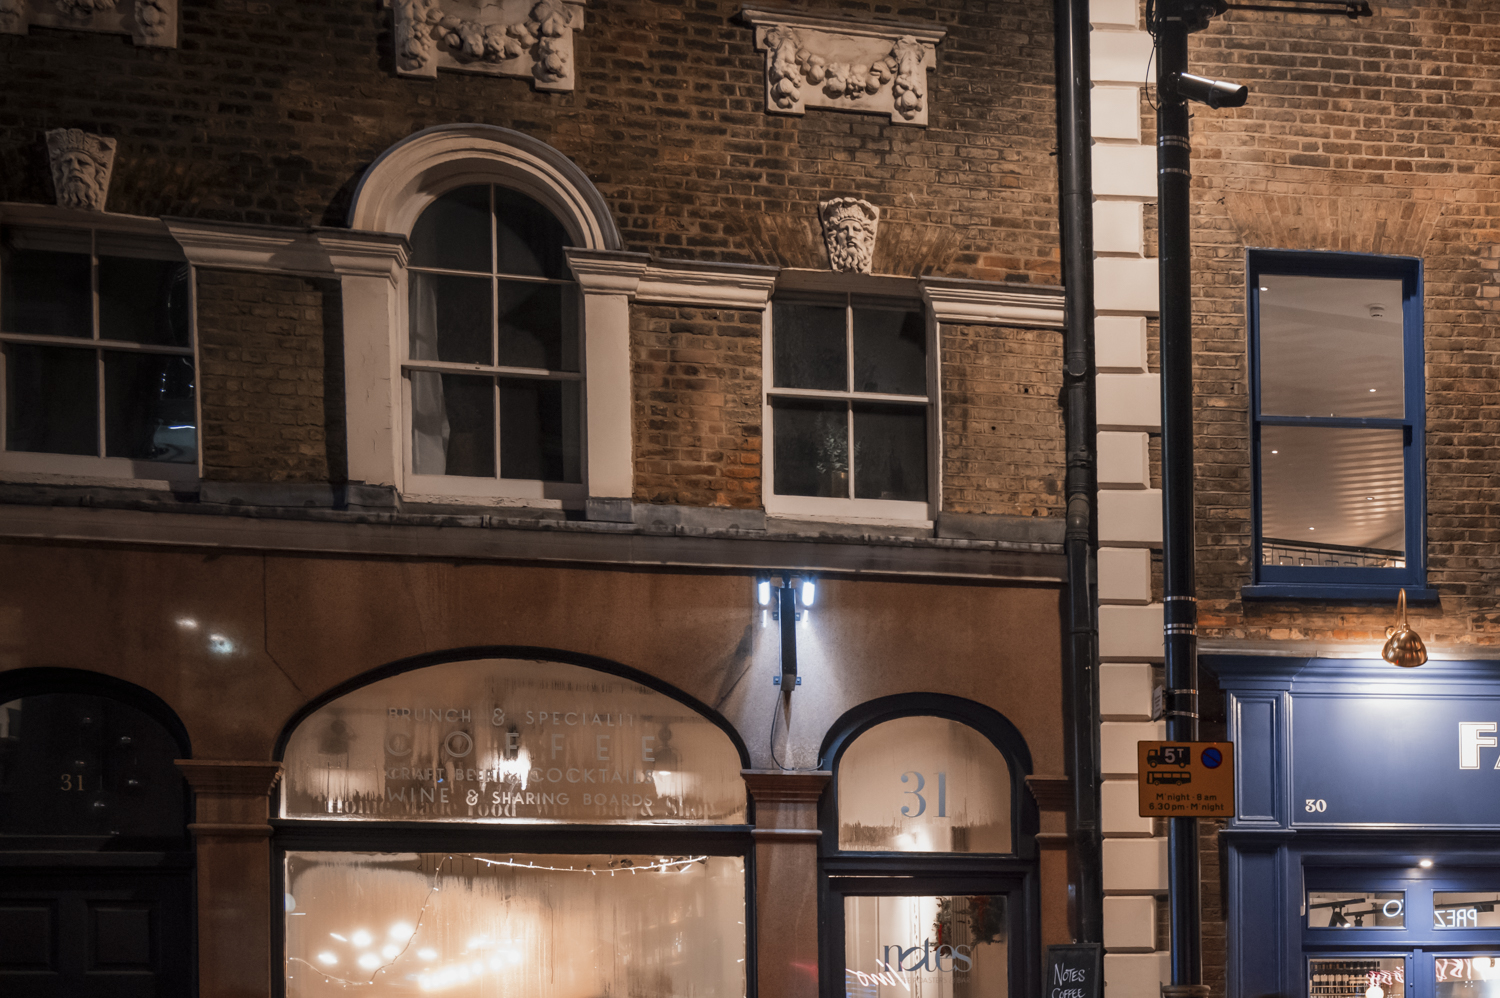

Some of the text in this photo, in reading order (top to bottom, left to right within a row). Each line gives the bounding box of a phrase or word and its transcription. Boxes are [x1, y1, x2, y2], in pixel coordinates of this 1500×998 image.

[387, 707, 634, 727] BRUNCH & SPECIALIT
[386, 730, 656, 762] COFFEE
[60, 773, 85, 791] 31
[385, 767, 445, 780] CRAFT
[529, 767, 654, 785] COCKTAILS
[387, 787, 653, 807] WINE & SHARING BOARDS
[900, 770, 951, 818] 31
[1149, 803, 1171, 811] 6.30
[1171, 804, 1185, 813] pm
[1305, 799, 1327, 813] 30
[883, 937, 973, 973] notes
